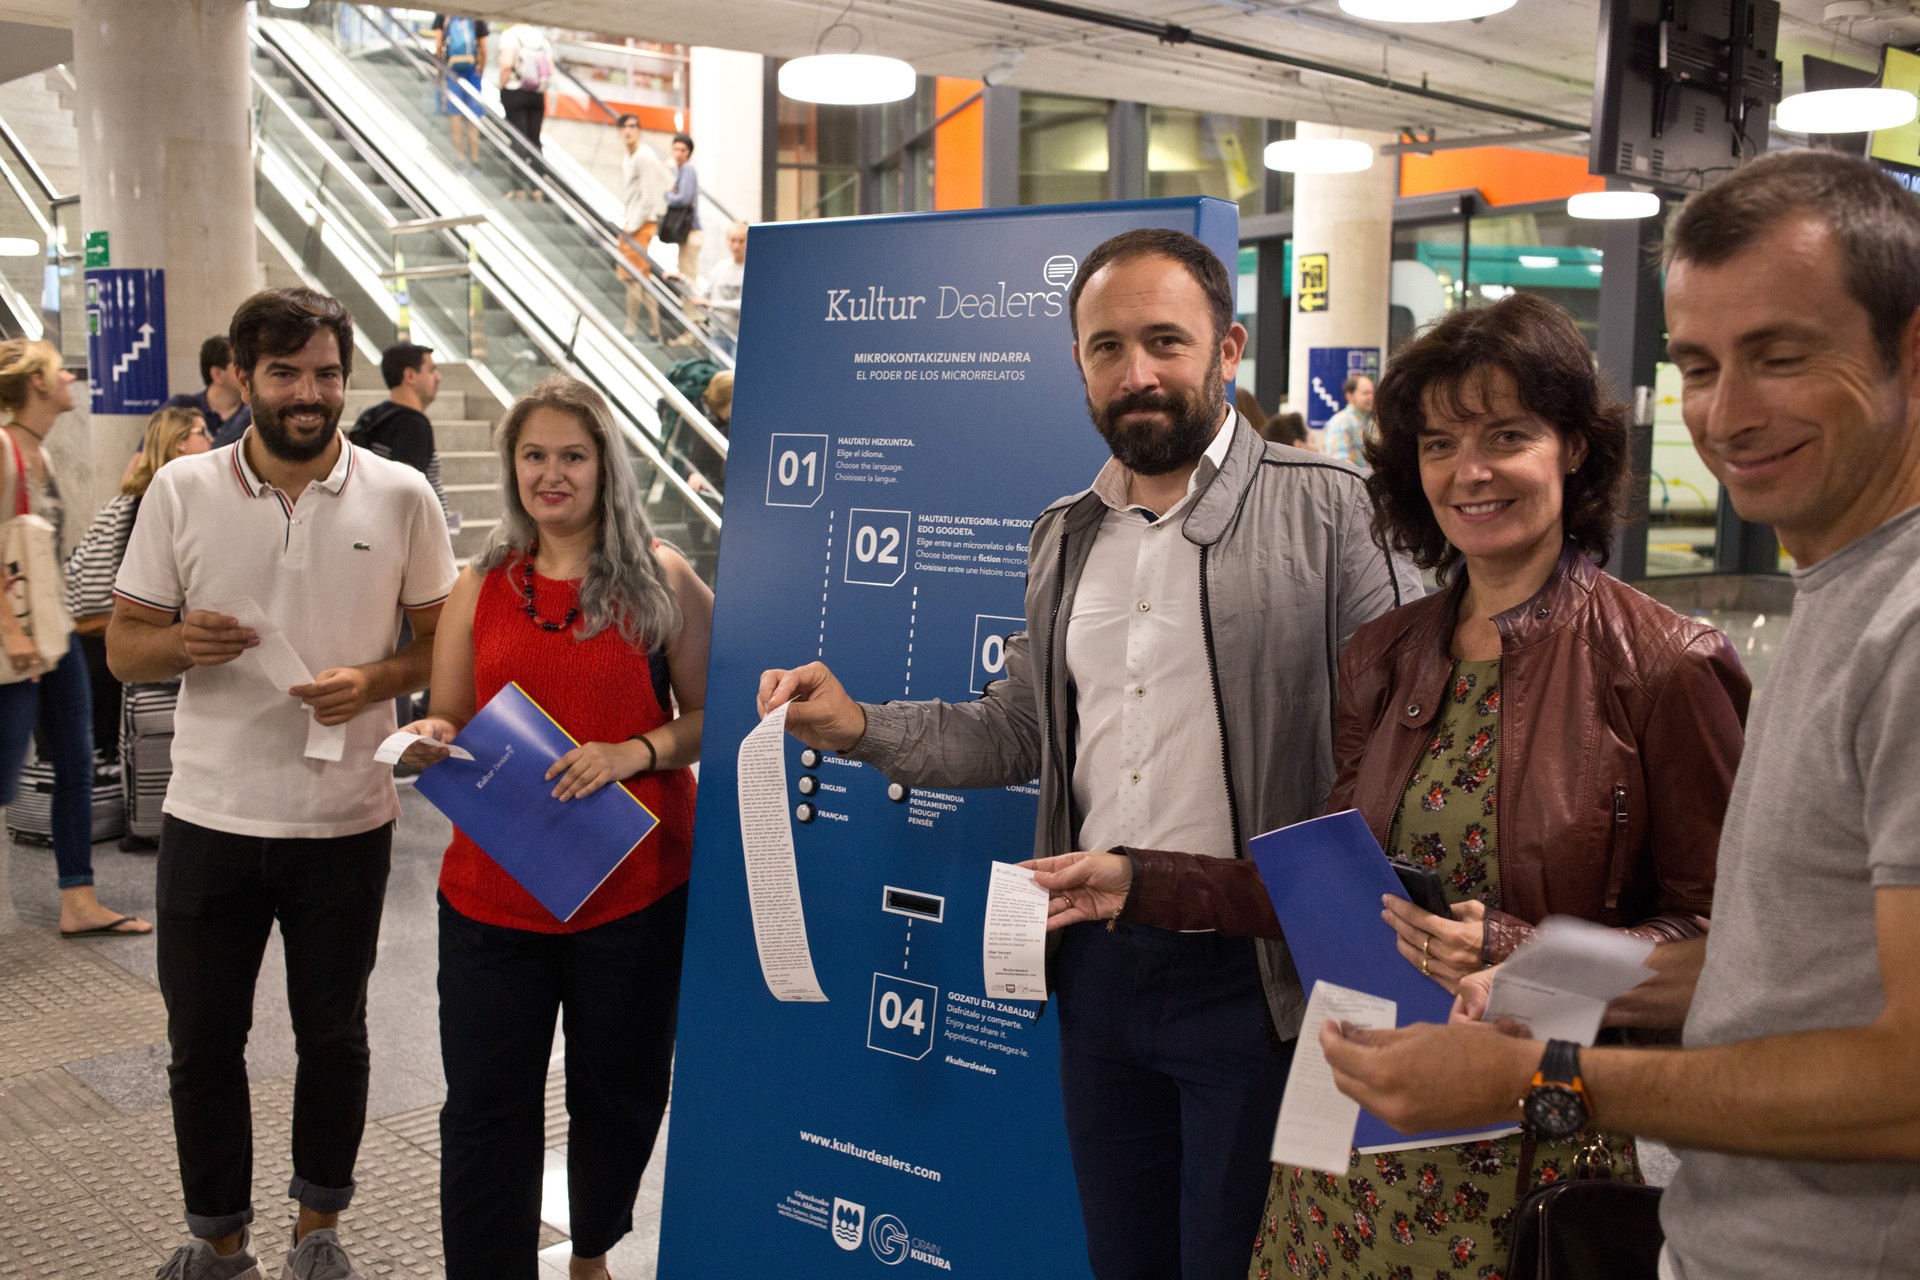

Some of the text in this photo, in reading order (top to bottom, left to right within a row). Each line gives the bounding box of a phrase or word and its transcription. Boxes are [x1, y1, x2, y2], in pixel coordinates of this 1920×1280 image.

[825, 281, 1062, 321] Kultur Dealers
[854, 352, 1031, 363] MIKROKONTAKIZUNEN INDARRA
[856, 370, 1025, 380] EL PODER DE LOS MICRORRELATOS
[838, 437, 915, 447] HAUTATU HIZKUNTZA.
[837, 449, 884, 458] Elige el idioma.
[778, 450, 817, 487] 01
[836, 461, 904, 473] Choose the language.
[835, 473, 898, 484] Choisissez la langue.
[918, 514, 953, 524] HAUTATU
[954, 516, 1001, 526] KATEGORIA:
[917, 525, 975, 536] EDO GOGOETA.
[855, 525, 900, 564] 02
[917, 537, 933, 548] Elige
[934, 540, 952, 548] entre
[963, 541, 1003, 550] microrrelato
[1005, 543, 1014, 551] de
[1016, 543, 1029, 552] ficc
[916, 549, 941, 558] Choose
[942, 551, 971, 561] between
[978, 554, 1001, 563] fiction
[1002, 556, 1028, 565] micro-s
[914, 561, 947, 572] Choisissez
[948, 565, 964, 573] entre
[979, 567, 1003, 576] histoire
[1004, 569, 1027, 578] courte
[982, 634, 1005, 673] 0
[822, 756, 862, 768] CASTELLANO
[476, 770, 494, 789] Kultur
[820, 783, 847, 793] ENGLISH
[910, 788, 964, 803] PENTSAMENDUA
[1006, 785, 1040, 796] CONFIRM
[909, 797, 957, 812] PENSAMIENTO
[818, 810, 849, 821] FRANÇAIS
[909, 807, 940, 818] THOUGHT
[908, 816, 933, 827] PENSÉE
[948, 991, 1037, 1020] GOZATU ETA ZABALDU.
[879, 991, 925, 1036] 04
[946, 1004, 1023, 1030] Disfrútalo y comparte.
[946, 1017, 1007, 1039] Enjoy and share it.
[944, 1029, 1029, 1058] Appréciez et partagez-le.
[945, 1055, 997, 1076] #kulturdealers
[800, 1130, 941, 1182] www.kulturdealers.com
[910, 1249, 951, 1271] KULTURA
